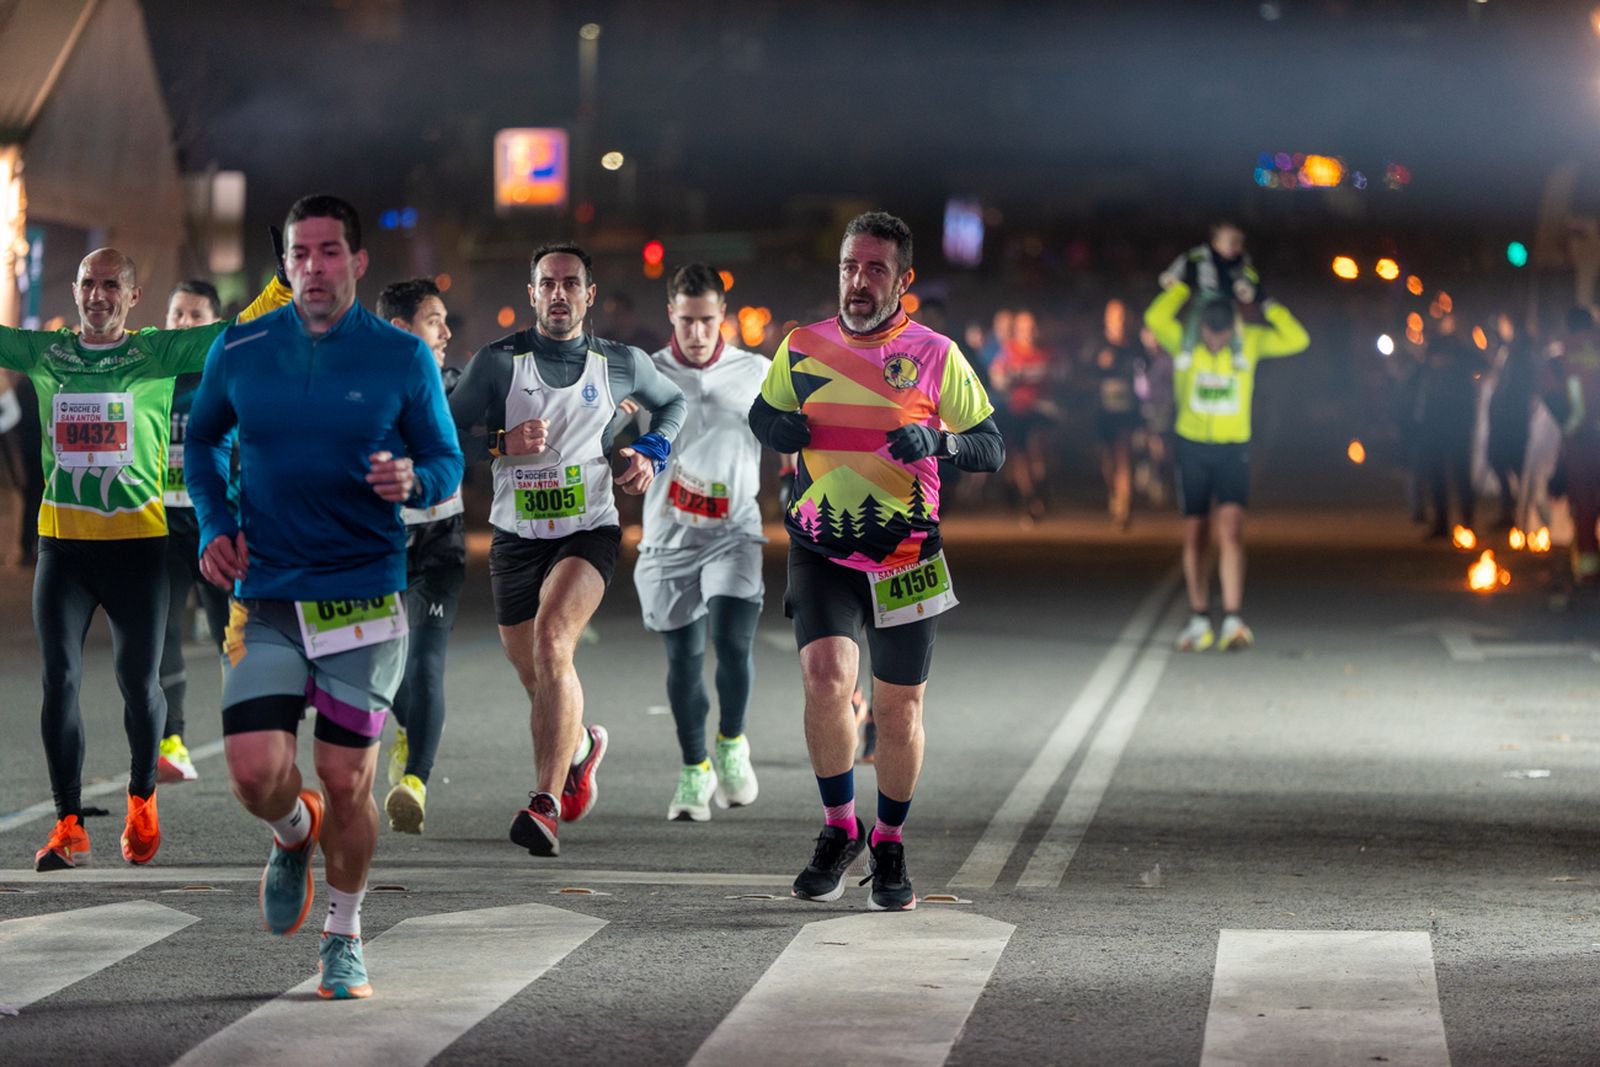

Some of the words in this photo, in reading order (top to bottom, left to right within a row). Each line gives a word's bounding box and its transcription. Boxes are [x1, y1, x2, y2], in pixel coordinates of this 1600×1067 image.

[91, 405, 101, 413] DE
[66, 422, 116, 444] 9432
[524, 472, 547, 480] NOCHE
[548, 470, 558, 479] DE
[518, 481, 532, 489] SAN
[524, 487, 576, 512] 3005
[878, 568, 894, 581] SAN
[889, 564, 939, 599] 4156
